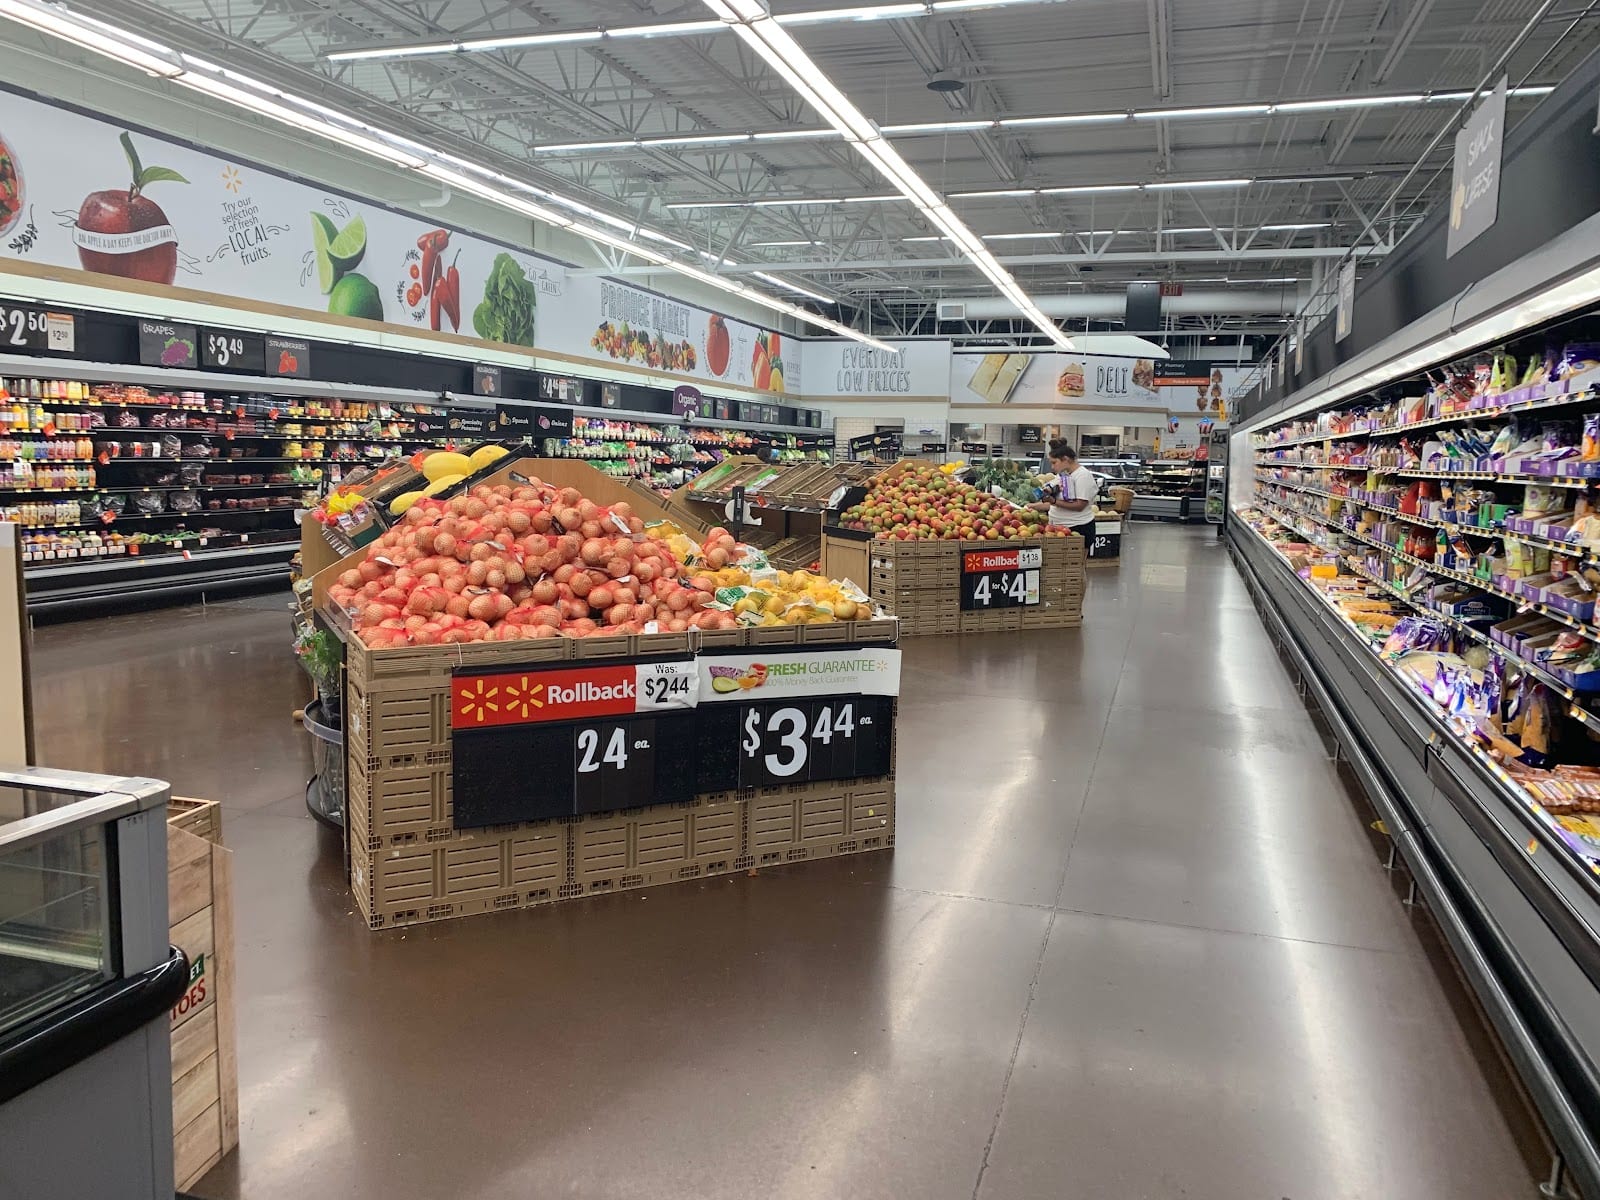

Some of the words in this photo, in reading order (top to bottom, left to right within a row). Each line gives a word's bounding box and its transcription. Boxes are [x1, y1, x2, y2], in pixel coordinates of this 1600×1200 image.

[222, 202, 236, 213] Try
[237, 197, 252, 208] our
[222, 205, 259, 225] selection
[228, 221, 238, 233] of
[237, 215, 259, 230] fresh
[118, 237, 133, 248] KEEPS
[228, 224, 269, 253] LOCAL
[600, 282, 650, 328] PRODUCE
[652, 298, 690, 338] MARKET
[142, 323, 175, 336] GRAPES
[842, 347, 907, 369] EVERYDAY
[837, 370, 863, 392] LOW
[867, 370, 911, 392] PRICES
[1096, 365, 1128, 394] DELI
[678, 392, 697, 407] Organic
[974, 575, 992, 605] 4
[992, 582, 1000, 590] for
[655, 664, 678, 674] Was:
[767, 663, 807, 676] FRESH
[808, 659, 876, 674] GUARANTEE
[785, 677, 807, 687] Money
[809, 676, 825, 685] Back
[825, 675, 858, 684] Guarantee
[547, 678, 636, 706] Rollback
